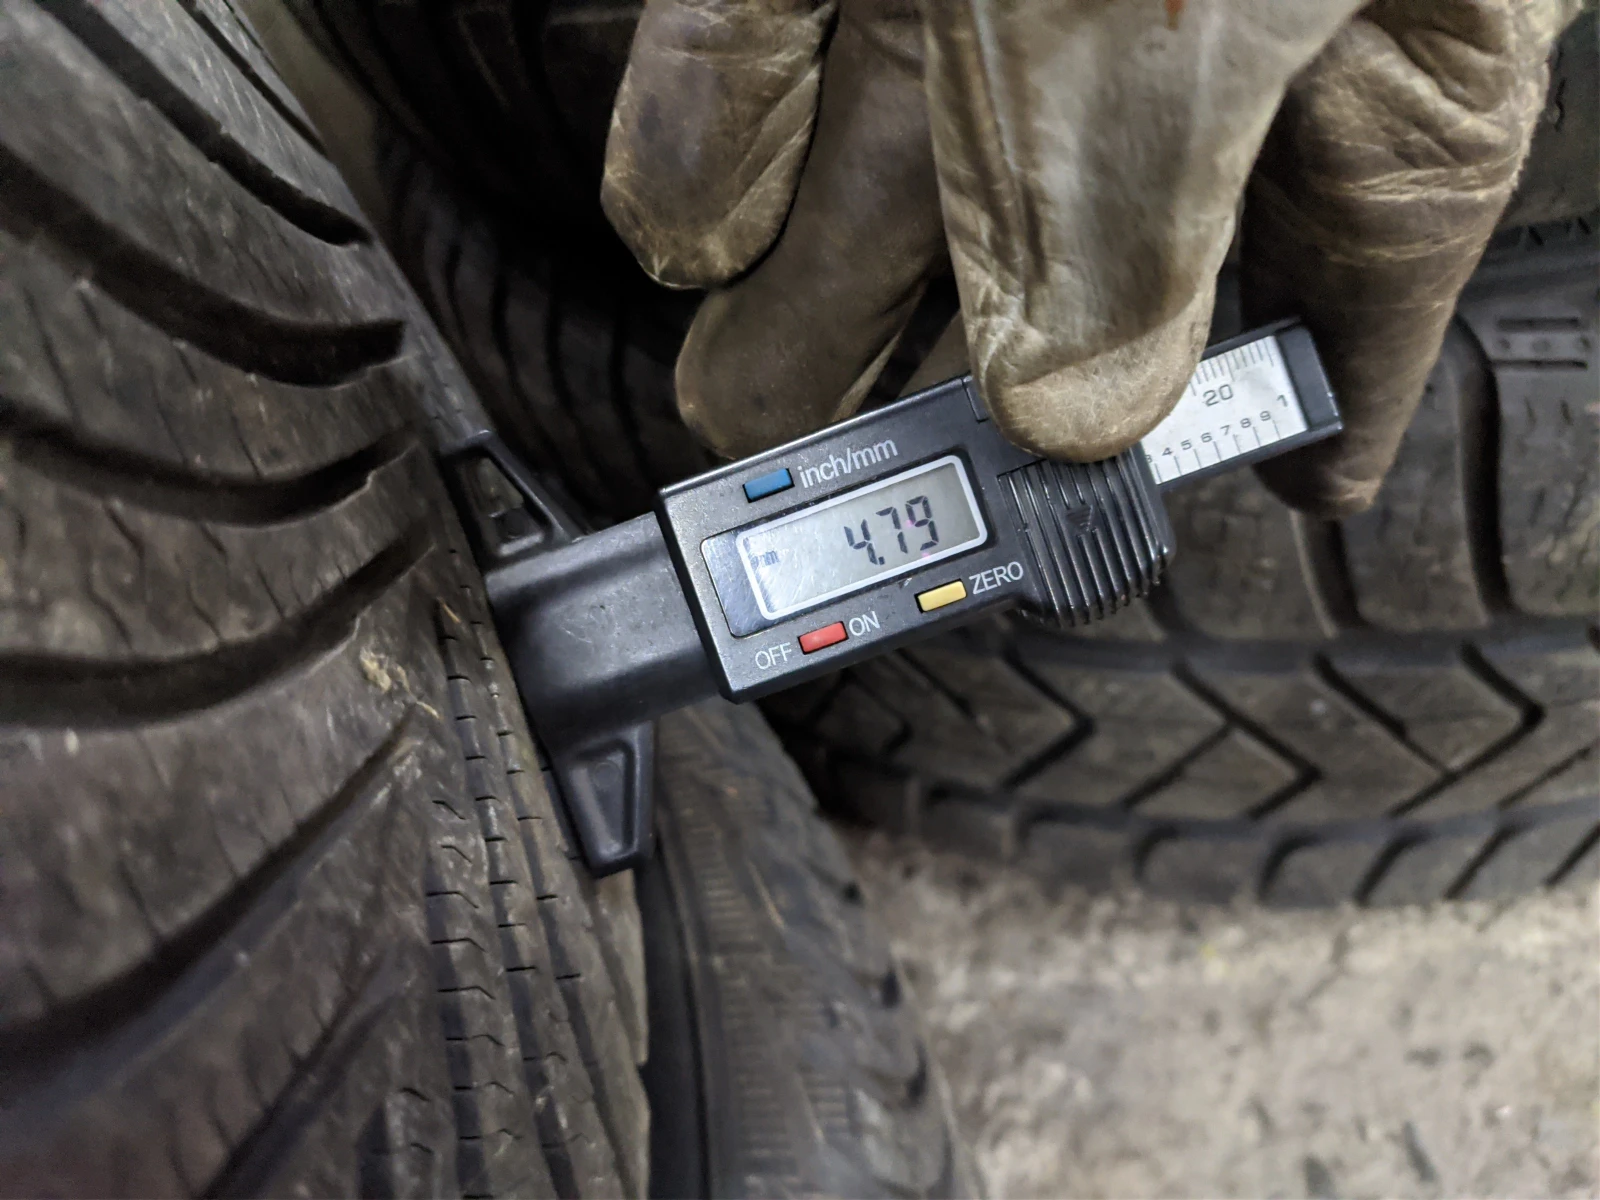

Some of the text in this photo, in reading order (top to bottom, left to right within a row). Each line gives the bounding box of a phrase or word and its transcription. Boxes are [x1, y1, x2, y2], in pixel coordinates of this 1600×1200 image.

[1203, 384, 1234, 407] 20
[1276, 394, 1288, 407] 1
[1162, 447, 1173, 456] 4
[1180, 440, 1193, 451] 5
[1201, 432, 1213, 443] 6
[1220, 425, 1231, 436] 7
[1240, 418, 1252, 429] 8
[1259, 410, 1271, 421] 9
[798, 439, 898, 489] inch/mm
[844, 495, 940, 566] 4.79
[969, 561, 1024, 595] ZERO
[754, 611, 881, 670] OFF ON
